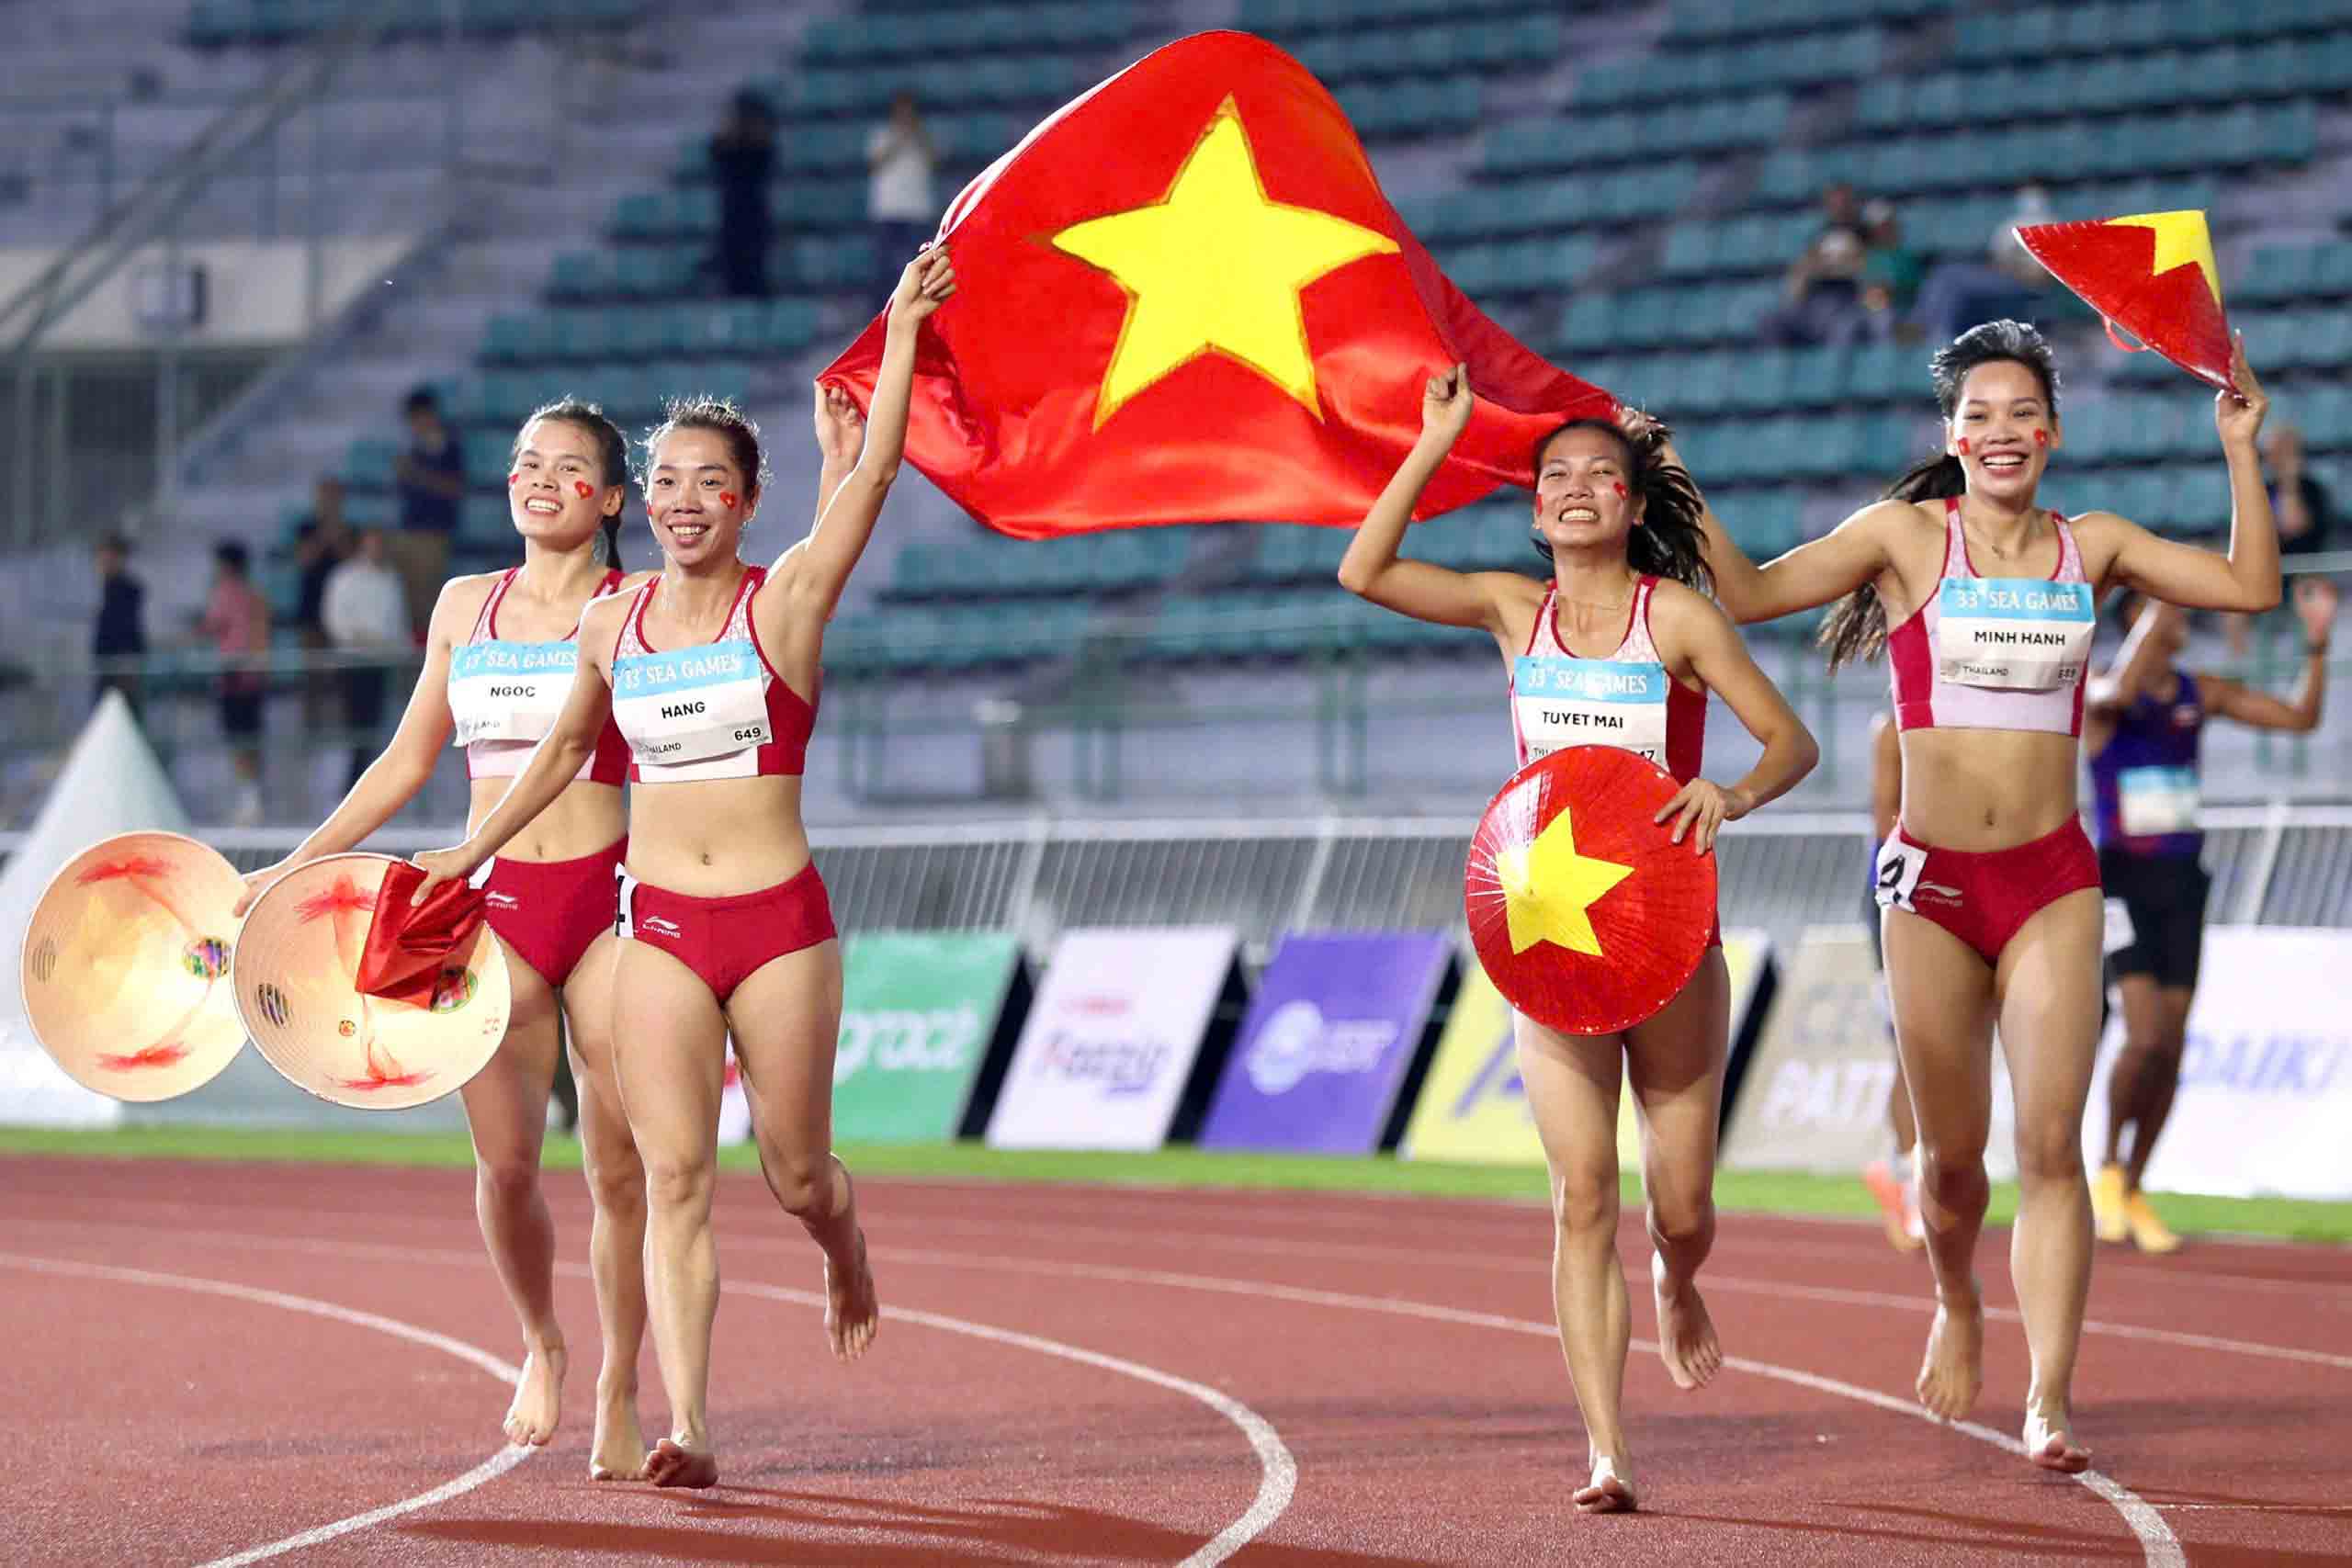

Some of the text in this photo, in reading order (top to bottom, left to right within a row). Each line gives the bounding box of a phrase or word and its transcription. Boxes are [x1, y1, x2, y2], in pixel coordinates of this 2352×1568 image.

[1988, 590, 2020, 611] SEA
[2026, 592, 2078, 611] GAMES
[1974, 631, 2065, 646] MINH HANH
[485, 652, 518, 669] SEA
[646, 662, 678, 684] SEA
[681, 654, 741, 679] GAMES
[490, 685, 536, 698] NGOC
[661, 701, 706, 719] HANG
[1543, 711, 1623, 728] TUYET MAI
[734, 727, 761, 741] 649
